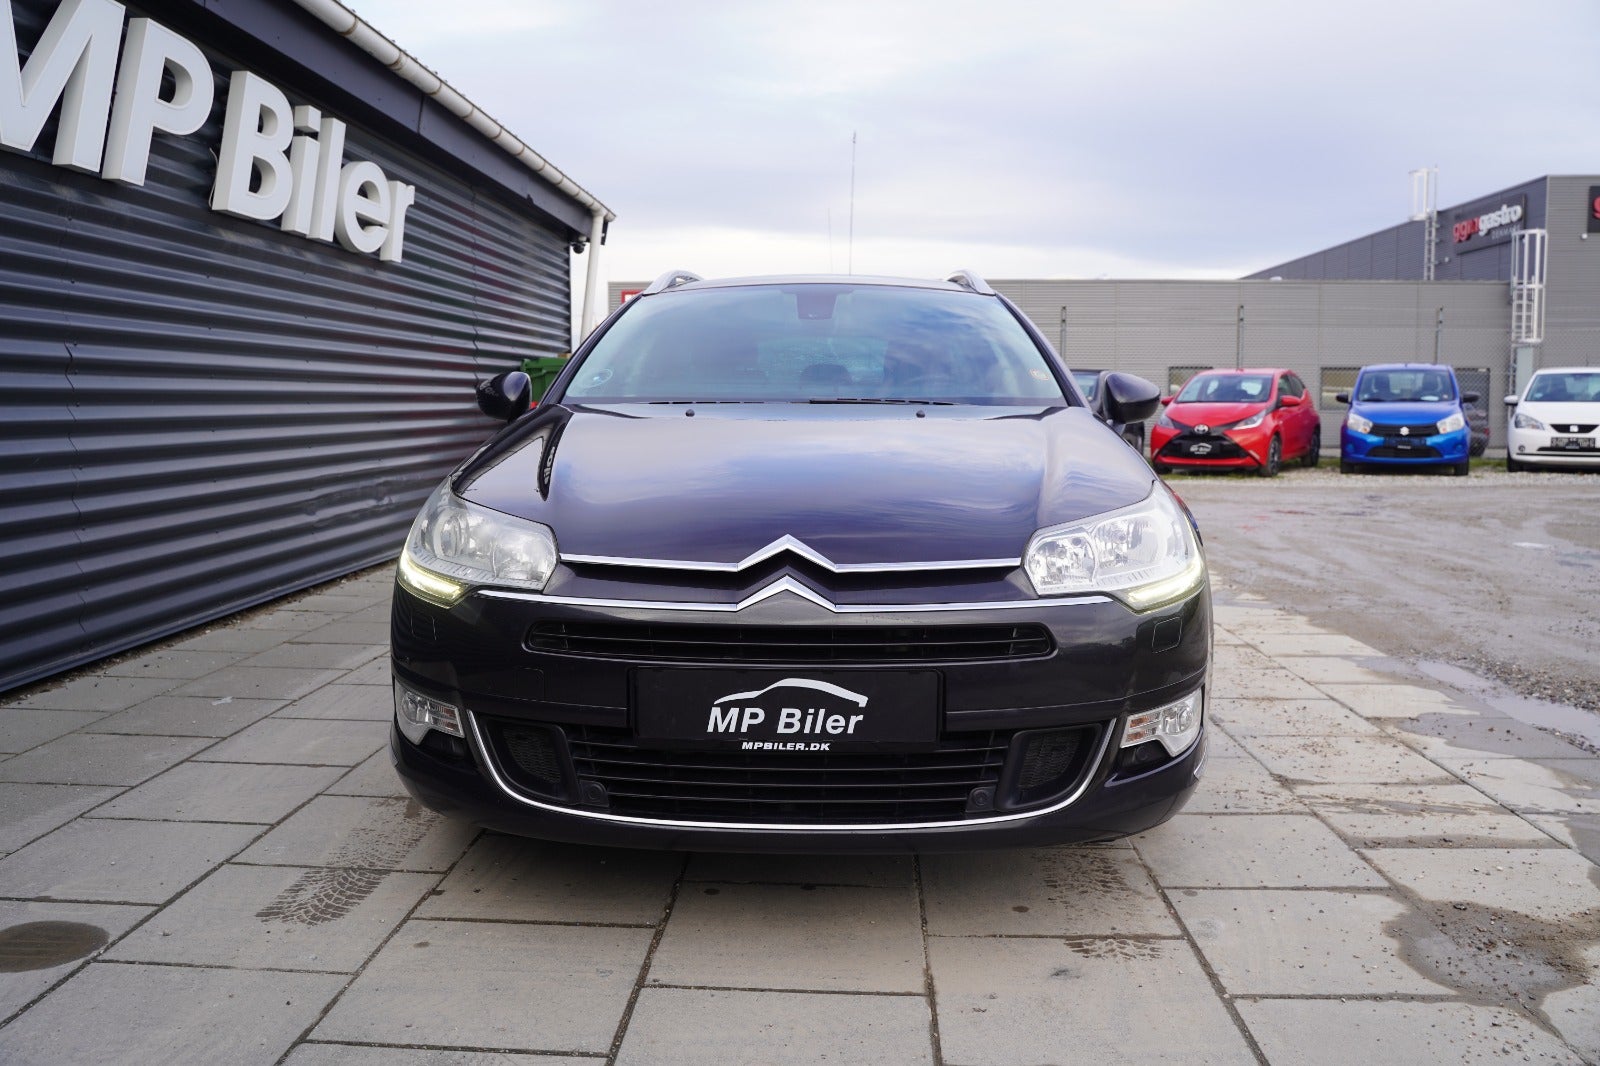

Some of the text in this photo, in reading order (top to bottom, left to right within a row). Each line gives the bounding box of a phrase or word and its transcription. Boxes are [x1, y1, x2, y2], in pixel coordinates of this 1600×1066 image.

[0, 0, 415, 264] MP Biler
[707, 707, 864, 734] MP Biler
[741, 741, 830, 751] MPBILER.DK
